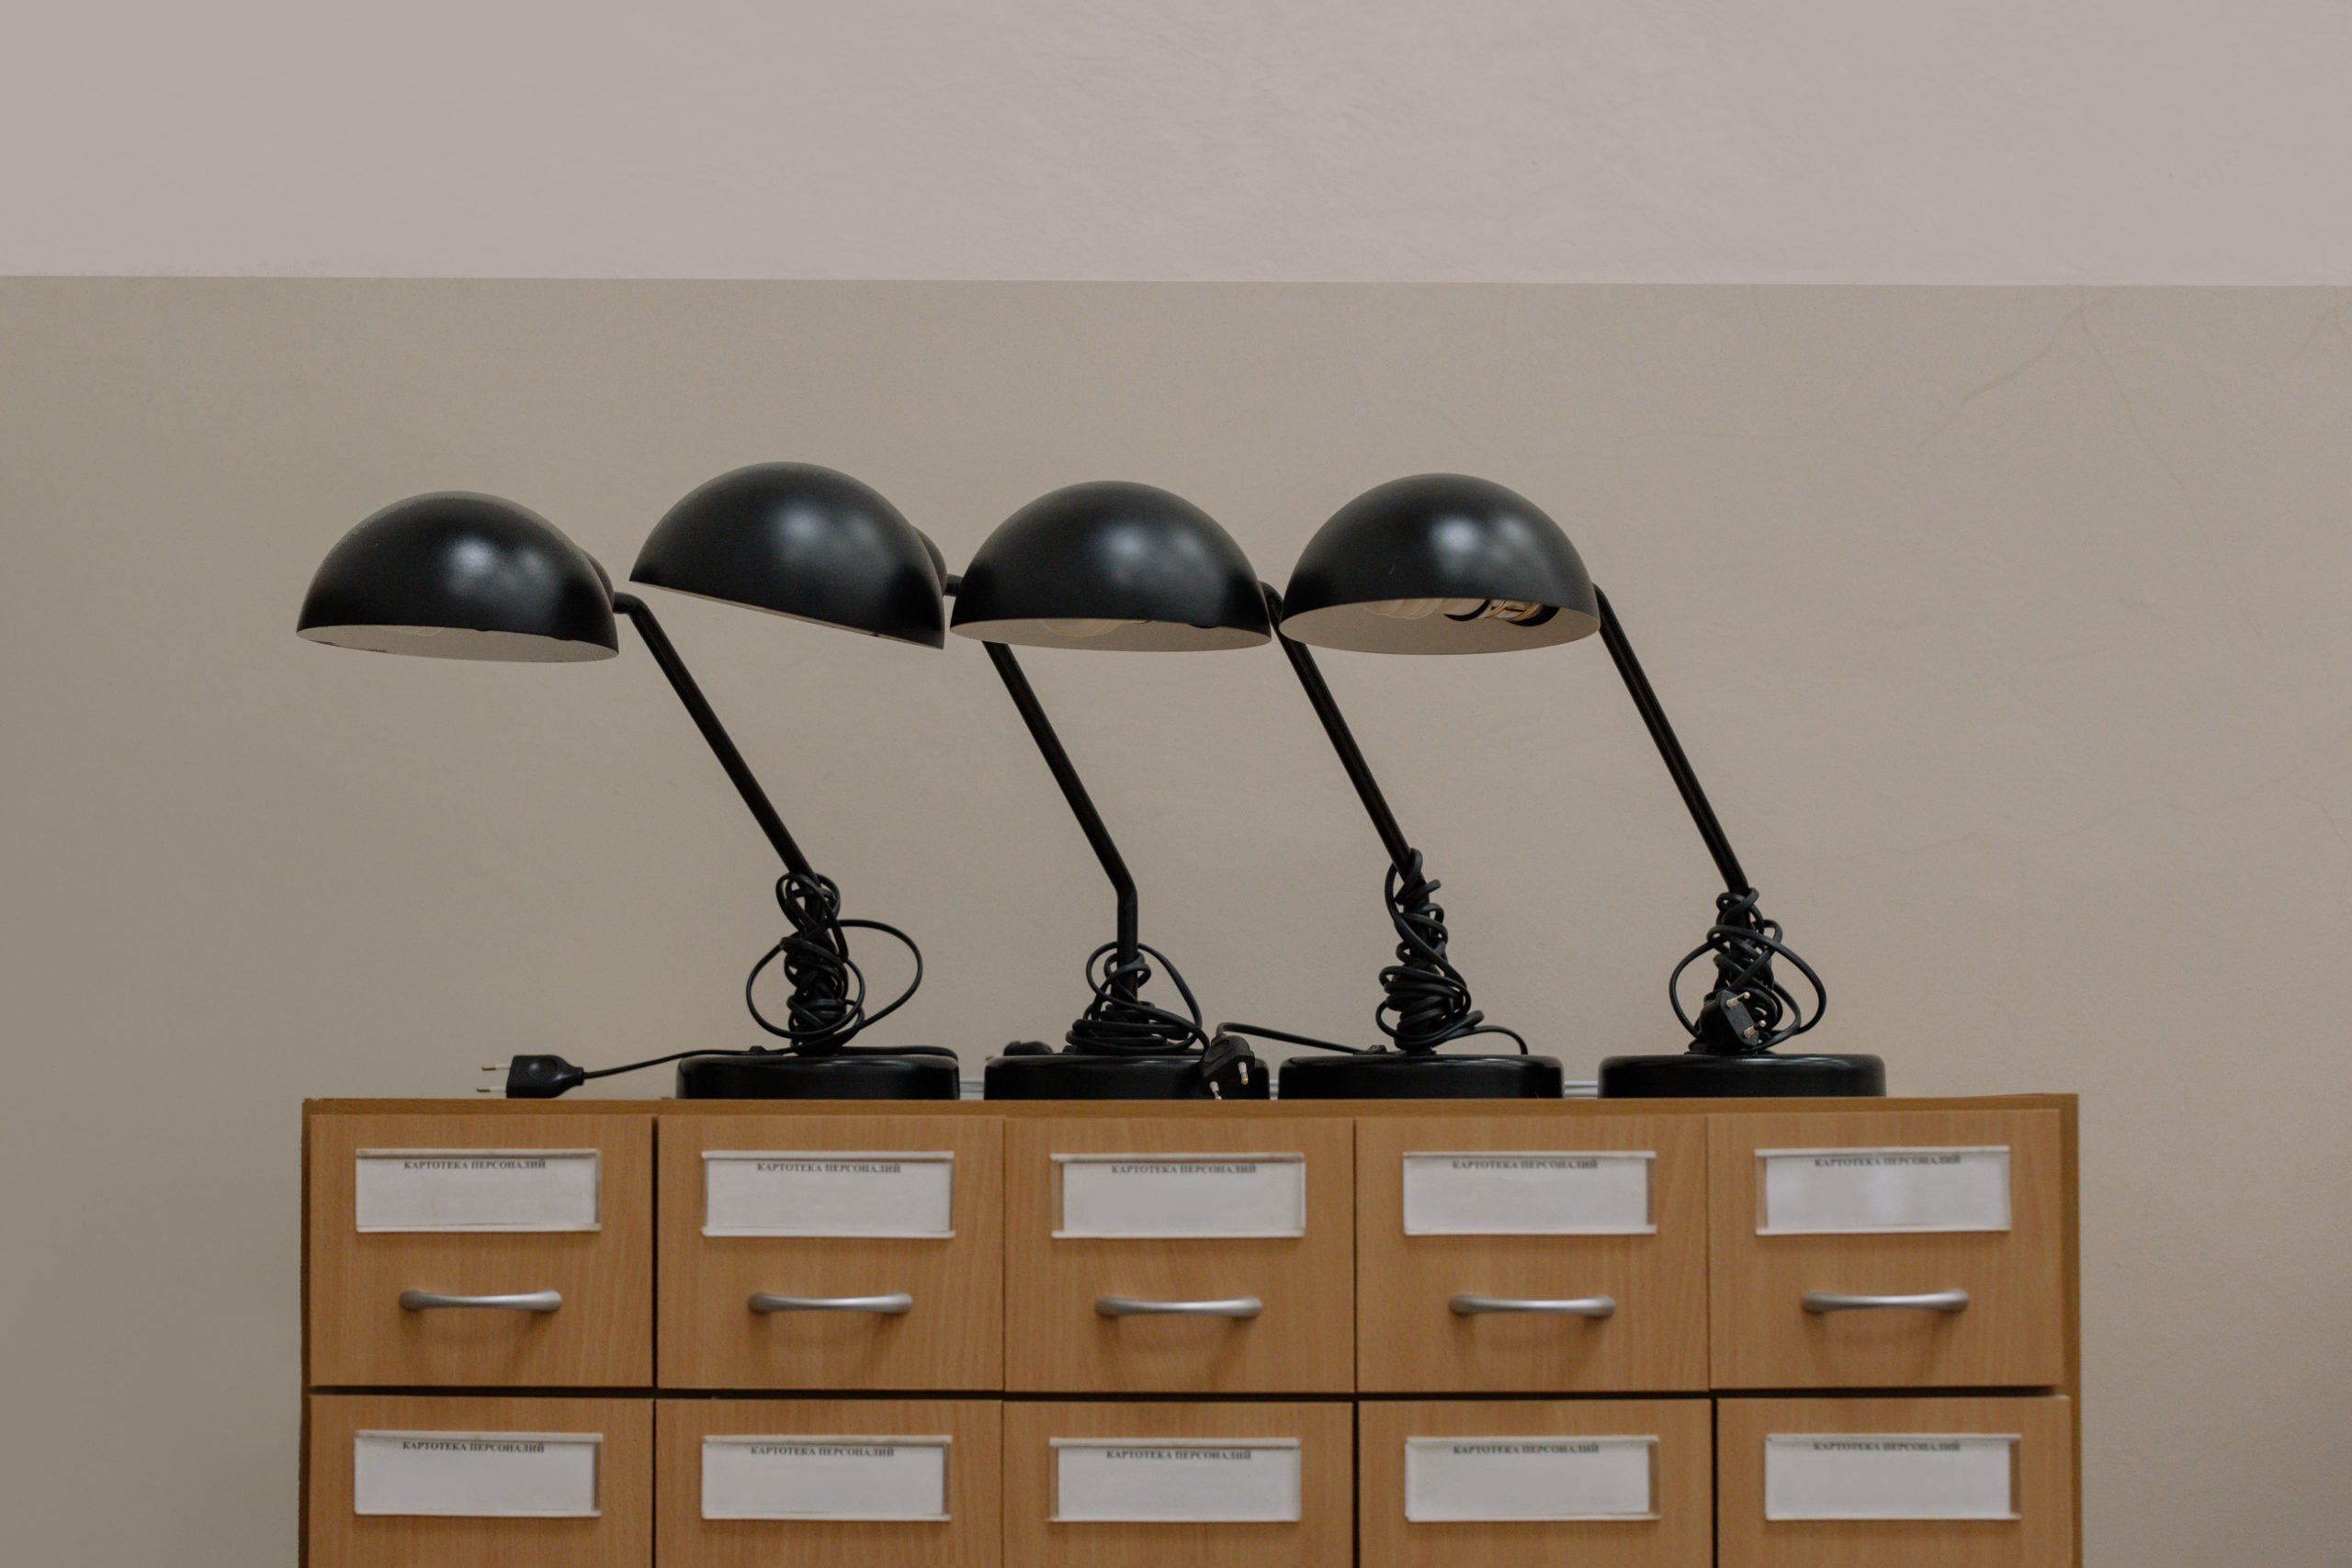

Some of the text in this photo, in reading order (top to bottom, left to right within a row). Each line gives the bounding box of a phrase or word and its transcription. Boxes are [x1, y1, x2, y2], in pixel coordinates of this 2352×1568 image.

[403, 1158, 547, 1170] КАРТОТЕКА ПЕРСОНАЛИЙ
[1452, 1158, 1599, 1169] КАРТОТЕКА ПЕРСОНАЛИЙ
[1815, 1155, 1962, 1168] КАРТОТЕКА ПЕРСОНАЛИЙ
[757, 1163, 901, 1174] КАРТОТЕКА ПЕРСОНАЛИЙ
[1111, 1164, 1257, 1175] КАРТОТЕКА ПЕРСОНАЛИЙ
[402, 1440, 545, 1453] КАРТОТЕКА ПЕРСОНАЛИЙ
[1453, 1443, 1600, 1454] КАРТОТЕКА ПЕРСОНАЛИЙ
[1813, 1440, 1962, 1451] КАРТОТЕКА ПЕРСОНАЛИЙ
[751, 1446, 895, 1457] КАРТОТЕКА ПЕРСОНАЛИЙ
[1106, 1450, 1252, 1461] КАРТОТЕКА ПЕРСОНАЛИЙ
